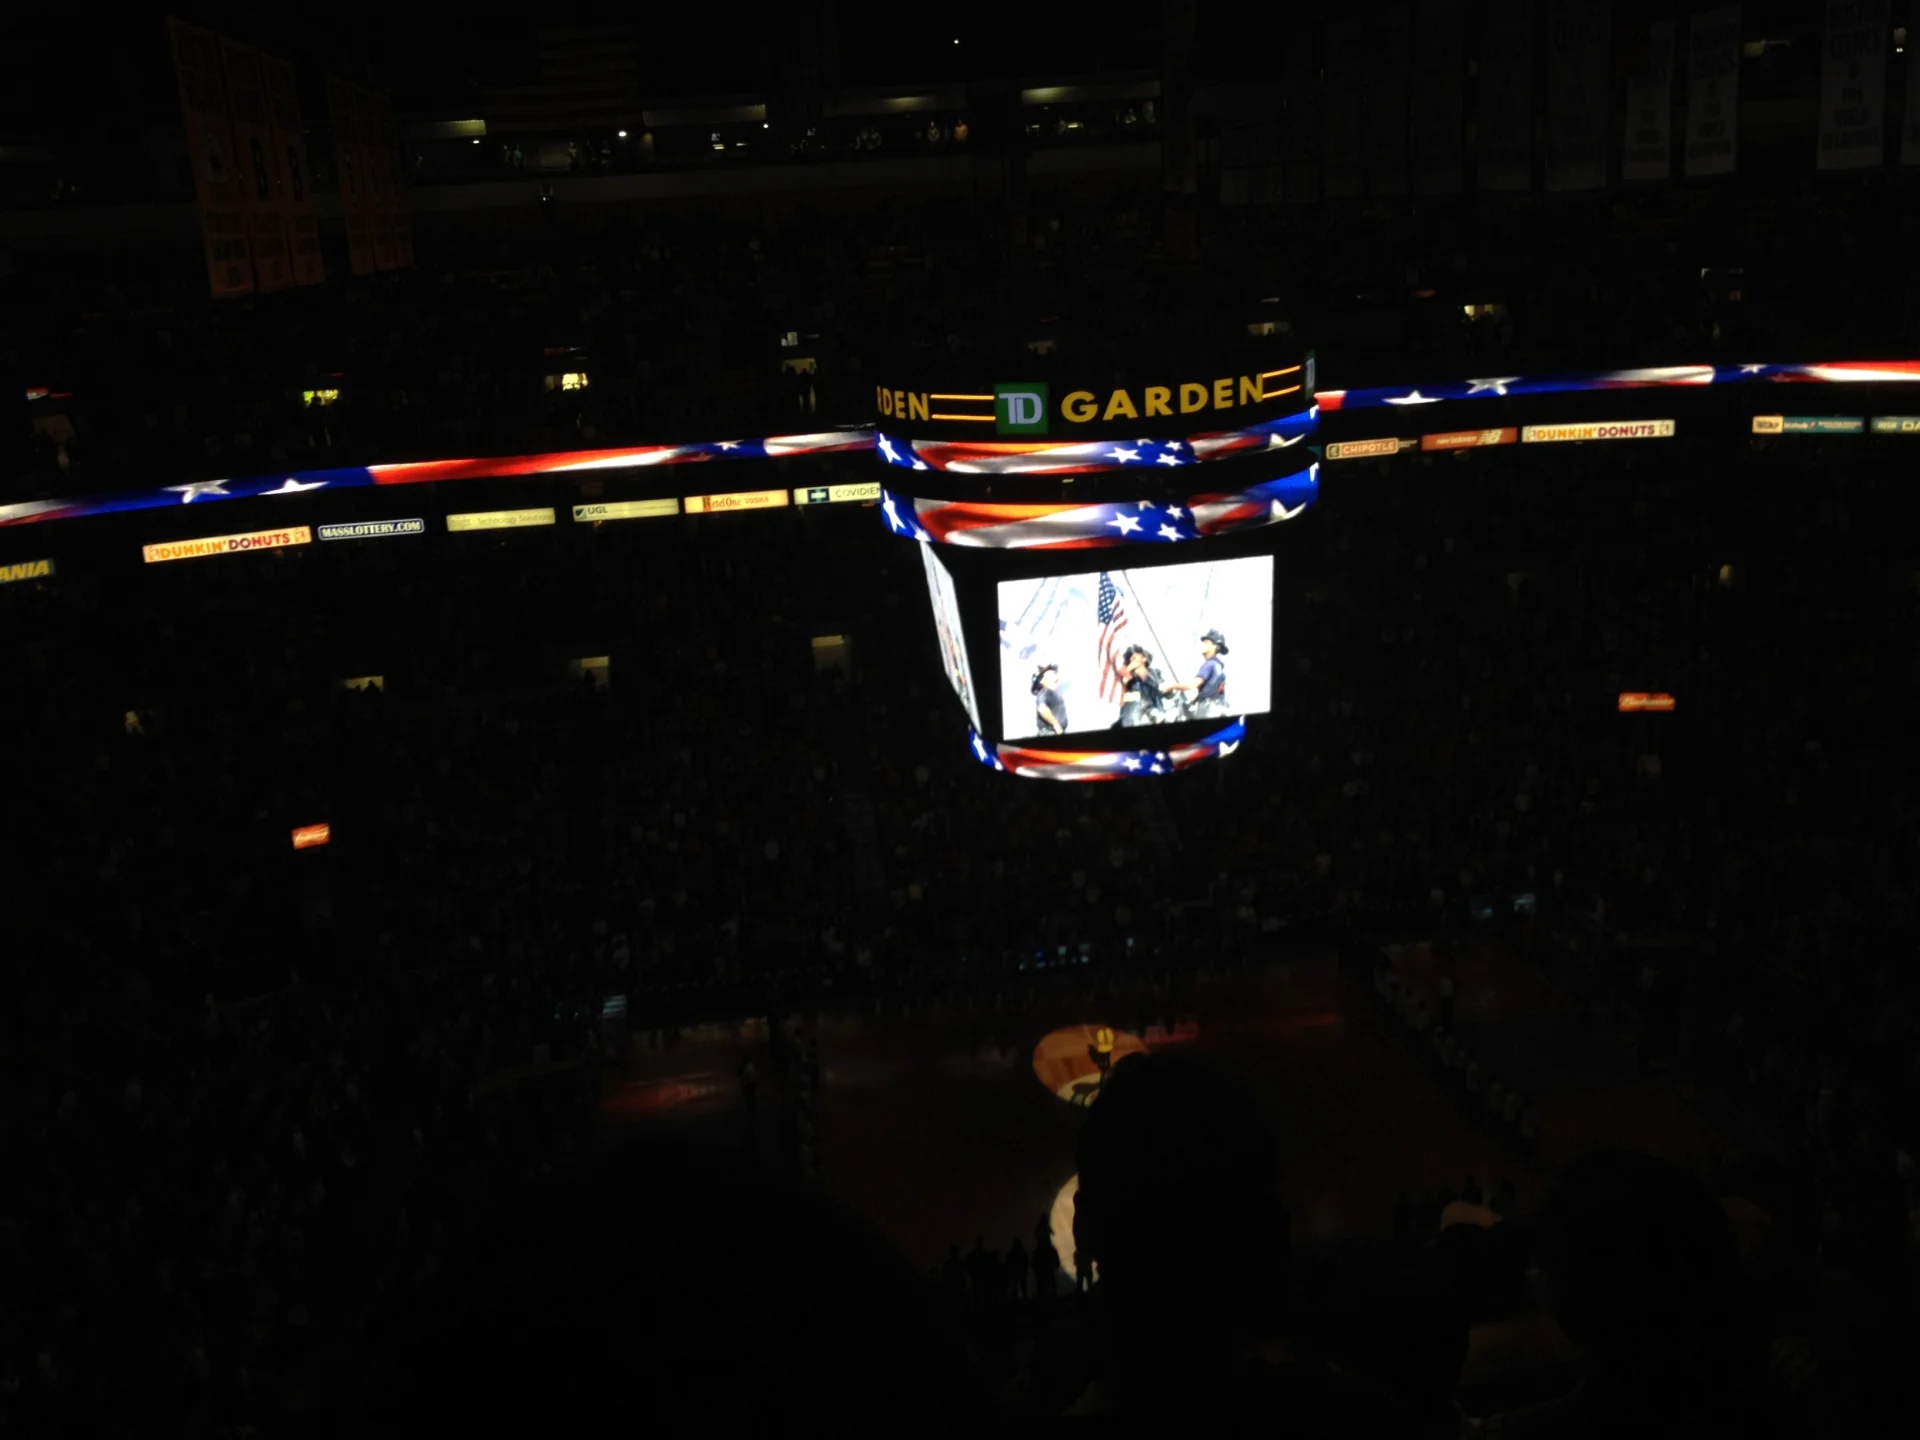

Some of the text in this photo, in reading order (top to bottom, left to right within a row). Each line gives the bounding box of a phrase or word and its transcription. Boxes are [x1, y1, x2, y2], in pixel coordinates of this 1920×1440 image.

[877, 385, 929, 422] DEN
[999, 373, 1264, 424] TD GARDEN
[1537, 424, 1656, 440] DUNKIN' DONUTS
[1342, 441, 1395, 455] CHIPOTLE
[587, 506, 608, 515] UGL
[321, 521, 421, 537] MASSLOTTERY.COM
[160, 532, 291, 559] DUNKIN' DONUTS
